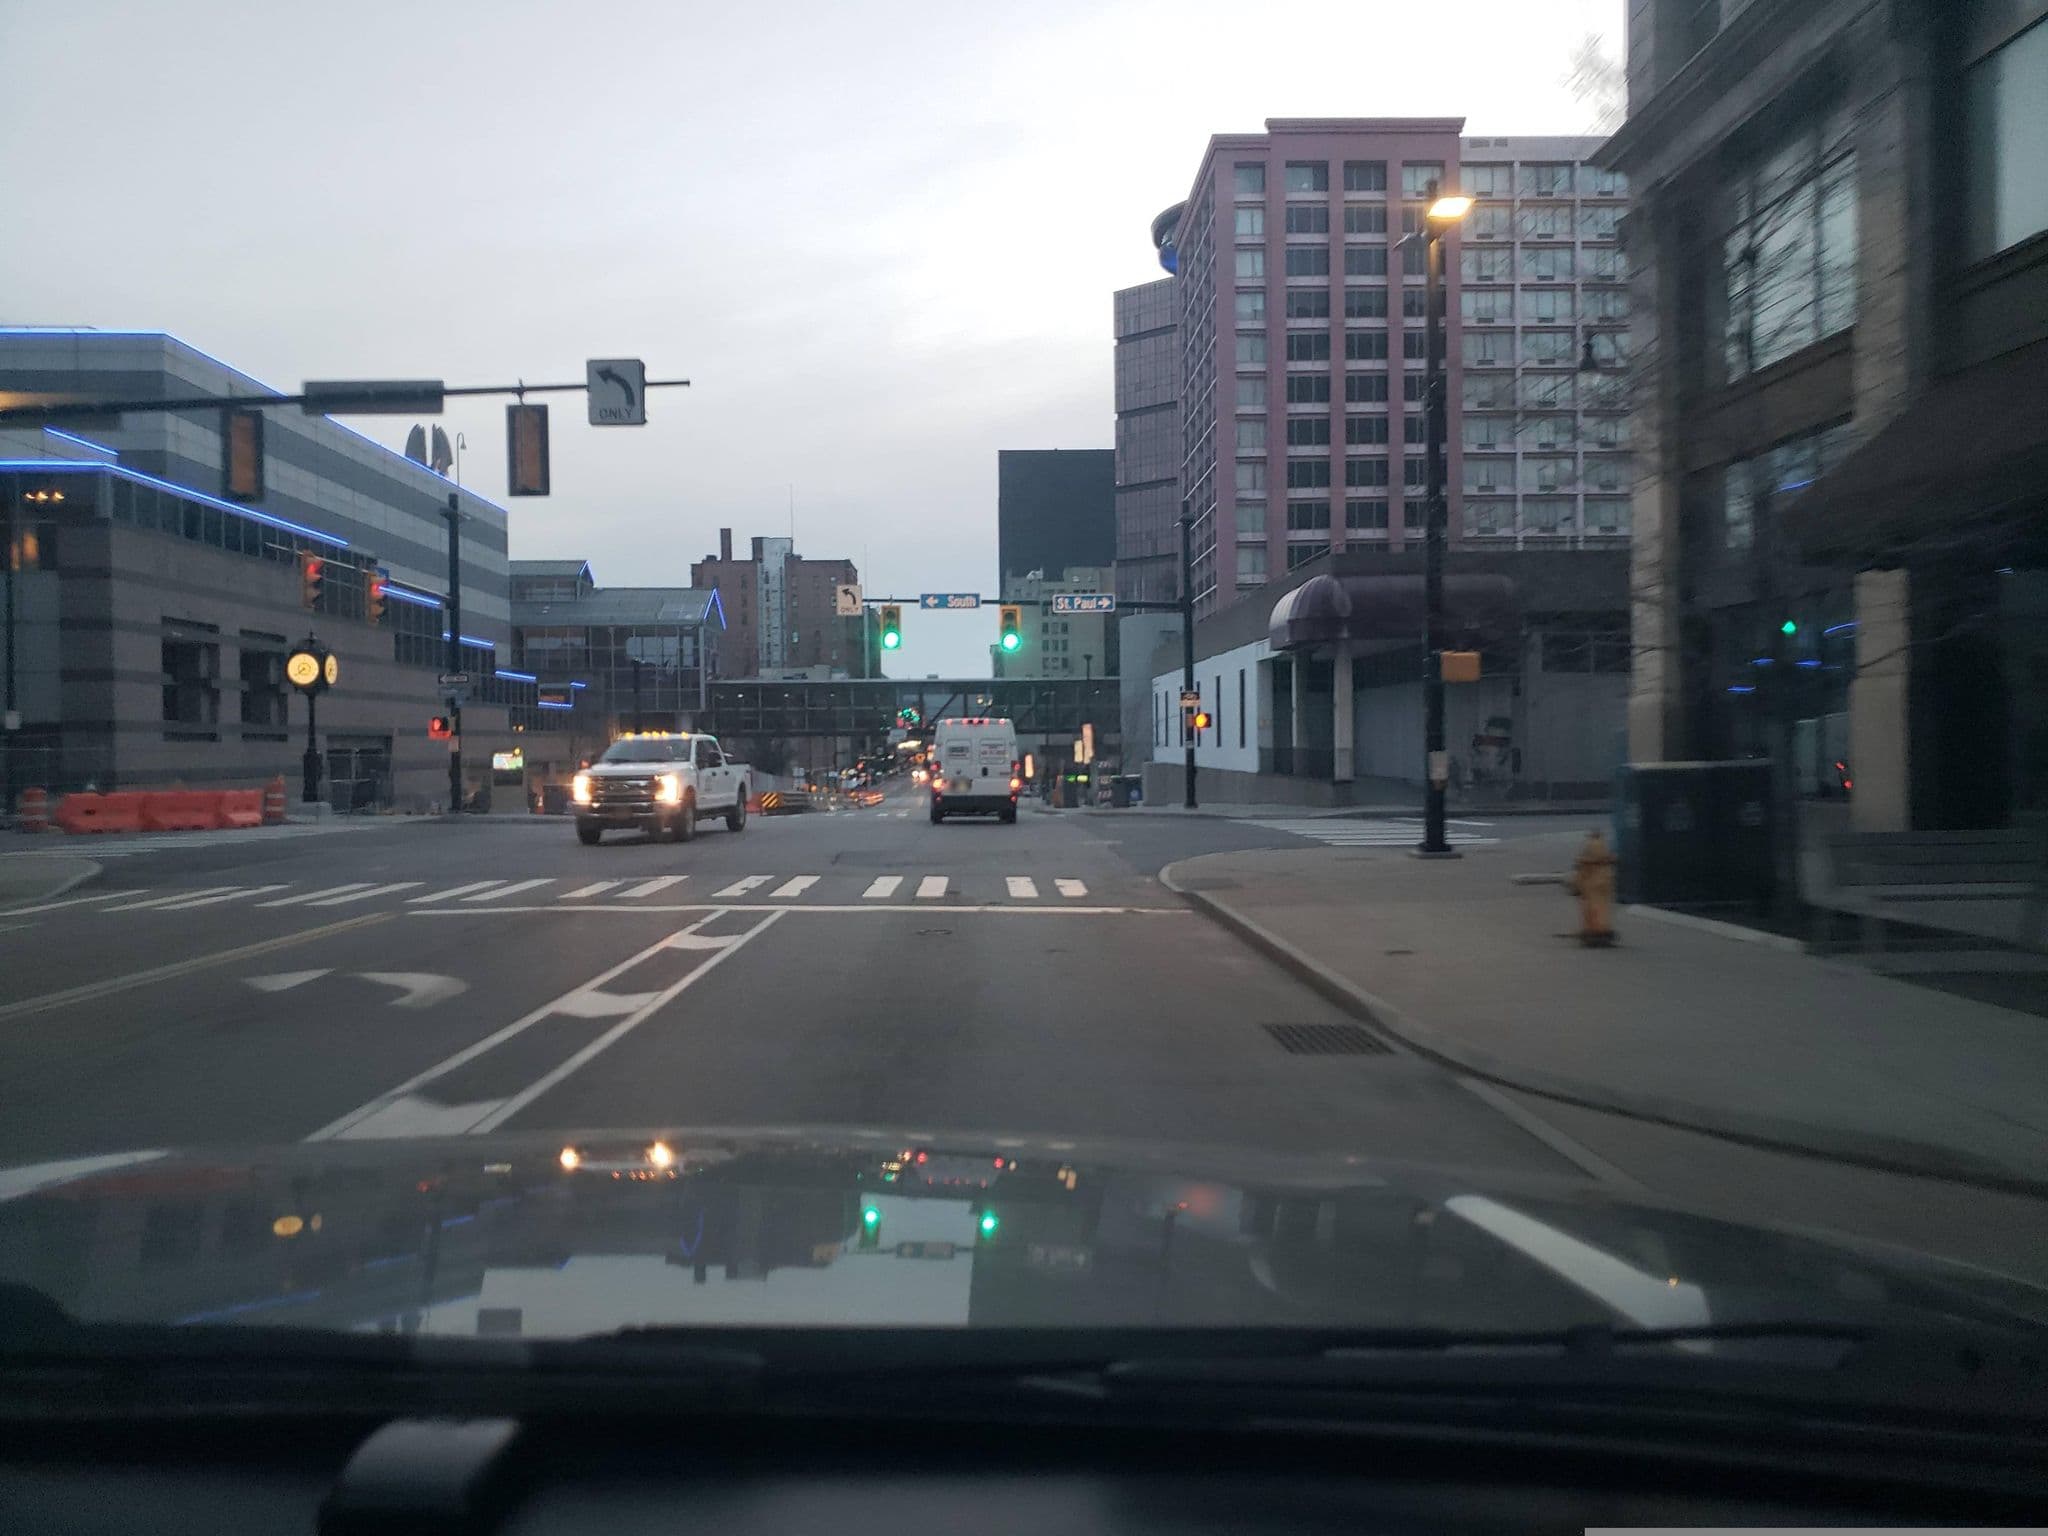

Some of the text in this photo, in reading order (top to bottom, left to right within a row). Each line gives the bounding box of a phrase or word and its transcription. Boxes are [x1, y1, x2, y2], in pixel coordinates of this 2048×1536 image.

[599, 408, 632, 420] ONLY
[947, 596, 977, 608] South
[1057, 596, 1097, 609] St. Paul
